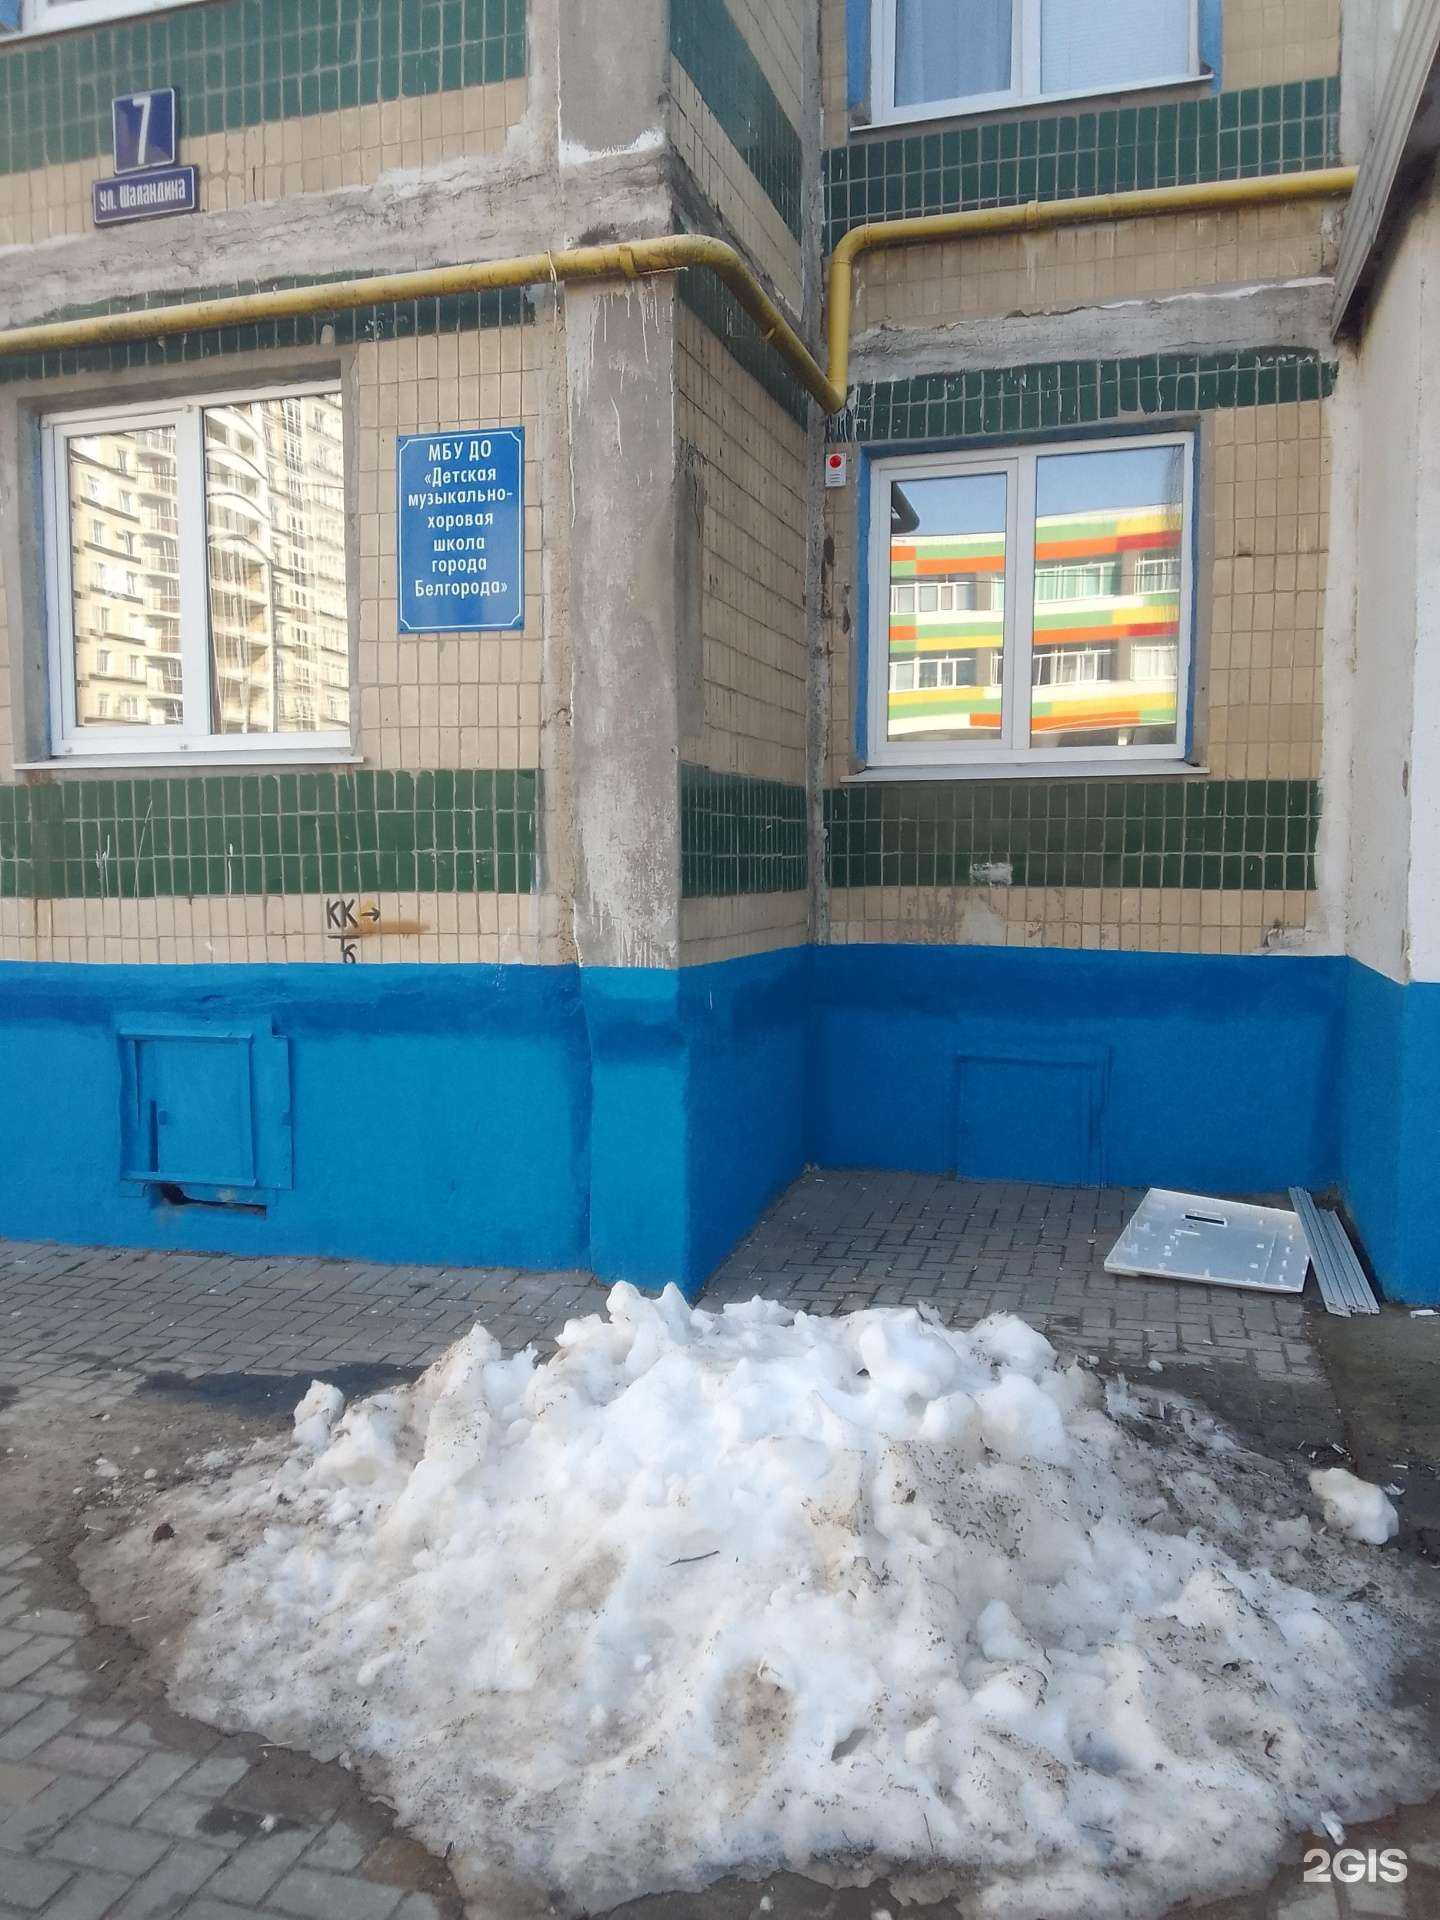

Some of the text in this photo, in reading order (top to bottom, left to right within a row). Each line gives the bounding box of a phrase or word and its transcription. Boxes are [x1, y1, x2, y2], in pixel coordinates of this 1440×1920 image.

[132, 95, 152, 165] 7
[99, 178, 187, 212] ул. Шаландина
[428, 440, 492, 462] МБУ ДО
[424, 466, 497, 488] «Детская
[408, 488, 514, 510] музыкально-
[427, 513, 494, 532] хоровая
[433, 537, 485, 552] школа
[431, 558, 487, 576] города
[415, 580, 508, 599] Белгорода»
